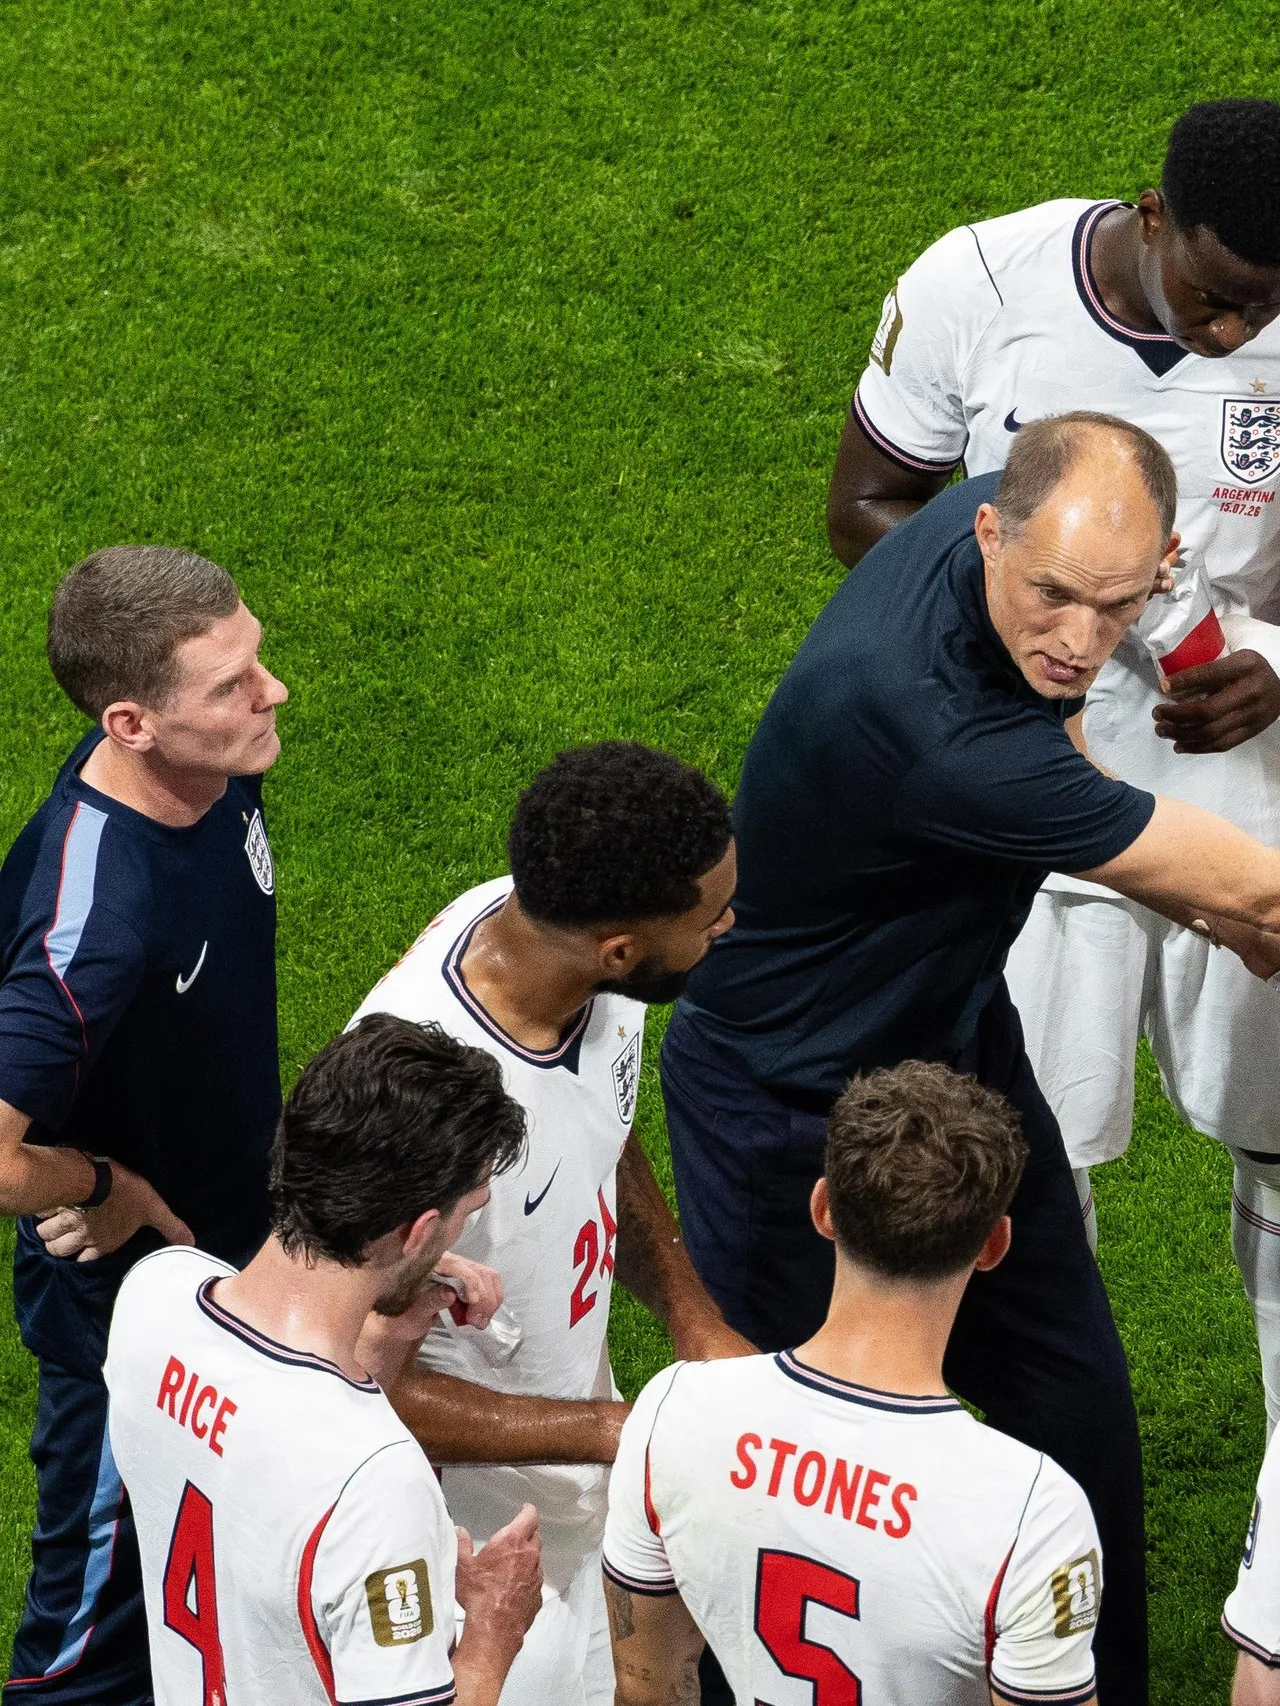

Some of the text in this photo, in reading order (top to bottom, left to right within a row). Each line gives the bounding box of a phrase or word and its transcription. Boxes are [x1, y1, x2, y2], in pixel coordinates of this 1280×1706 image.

[1212, 487, 1276, 503] ARGENTINA
[1219, 502, 1262, 518] 15.07.26
[156, 1355, 239, 1458] RICE
[729, 1431, 919, 1540] STONES
[163, 1480, 229, 1706] 4
[754, 1548, 862, 1706] 5
